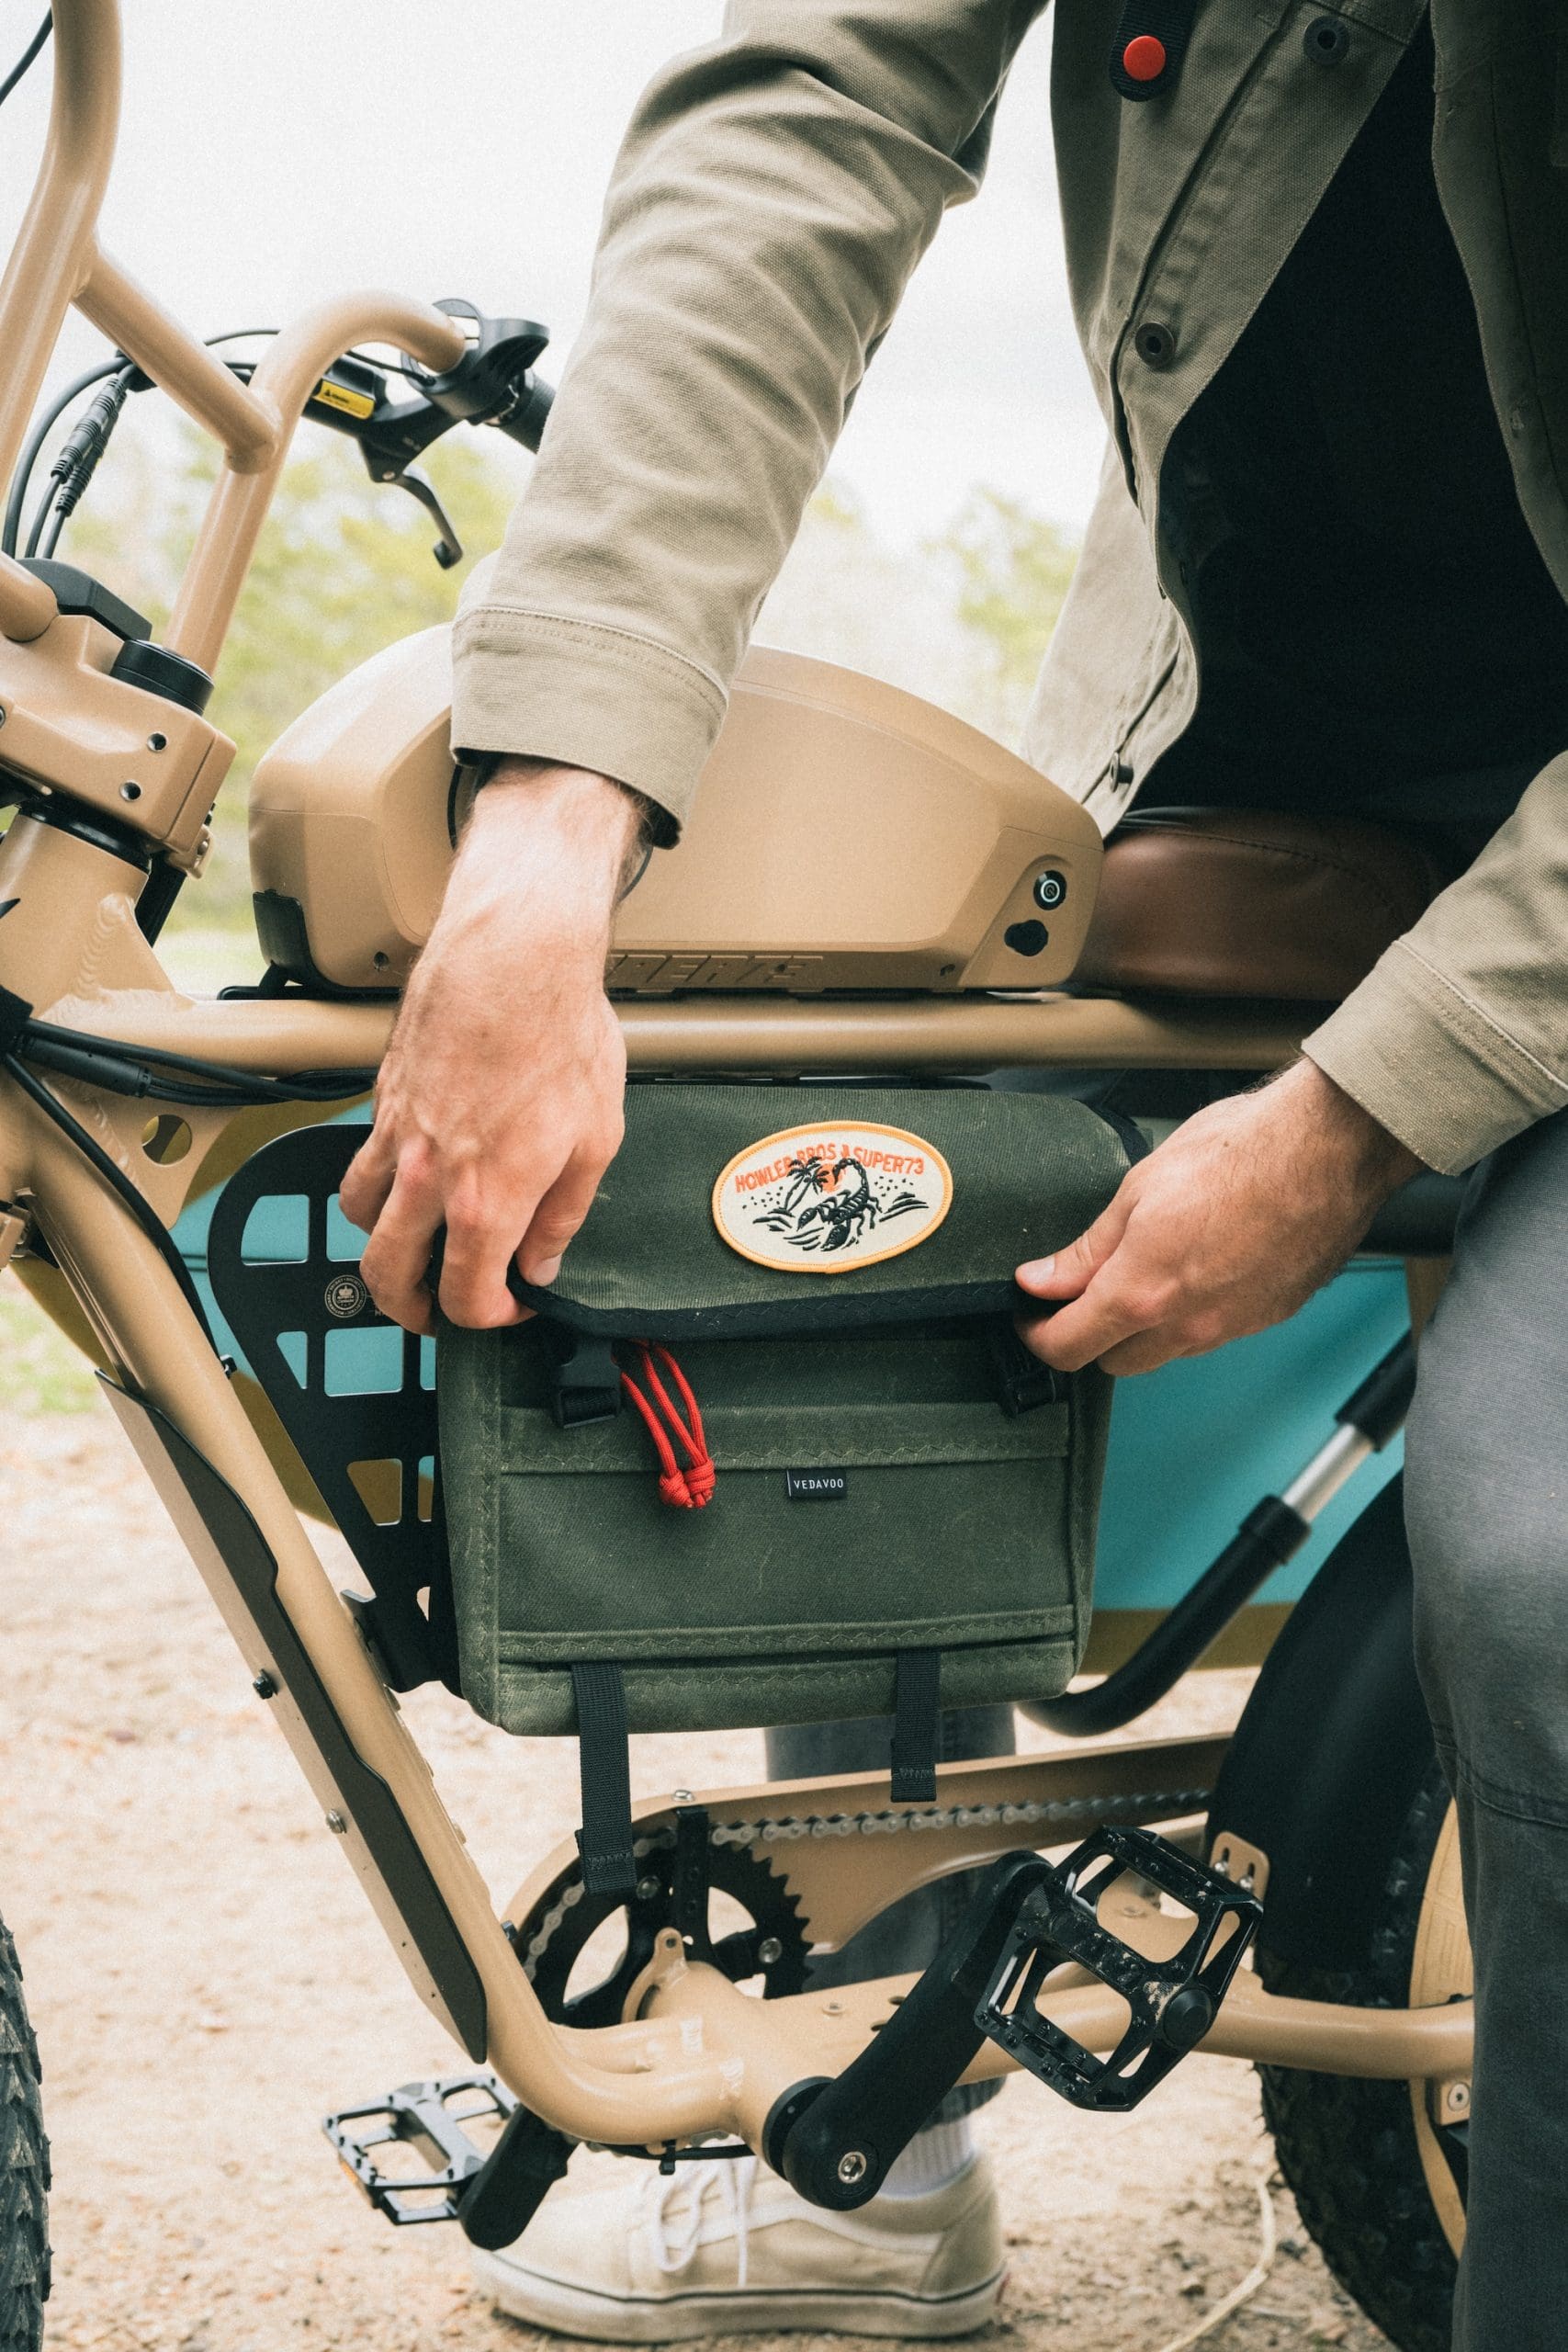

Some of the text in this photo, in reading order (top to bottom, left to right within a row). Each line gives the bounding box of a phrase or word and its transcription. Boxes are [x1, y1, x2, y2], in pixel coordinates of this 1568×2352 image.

[735, 1156, 794, 1193] HOWLER
[797, 1143, 837, 1162] BROS
[852, 1146, 924, 1175] SUPER73
[793, 1478, 844, 1489] VEDAVOO
